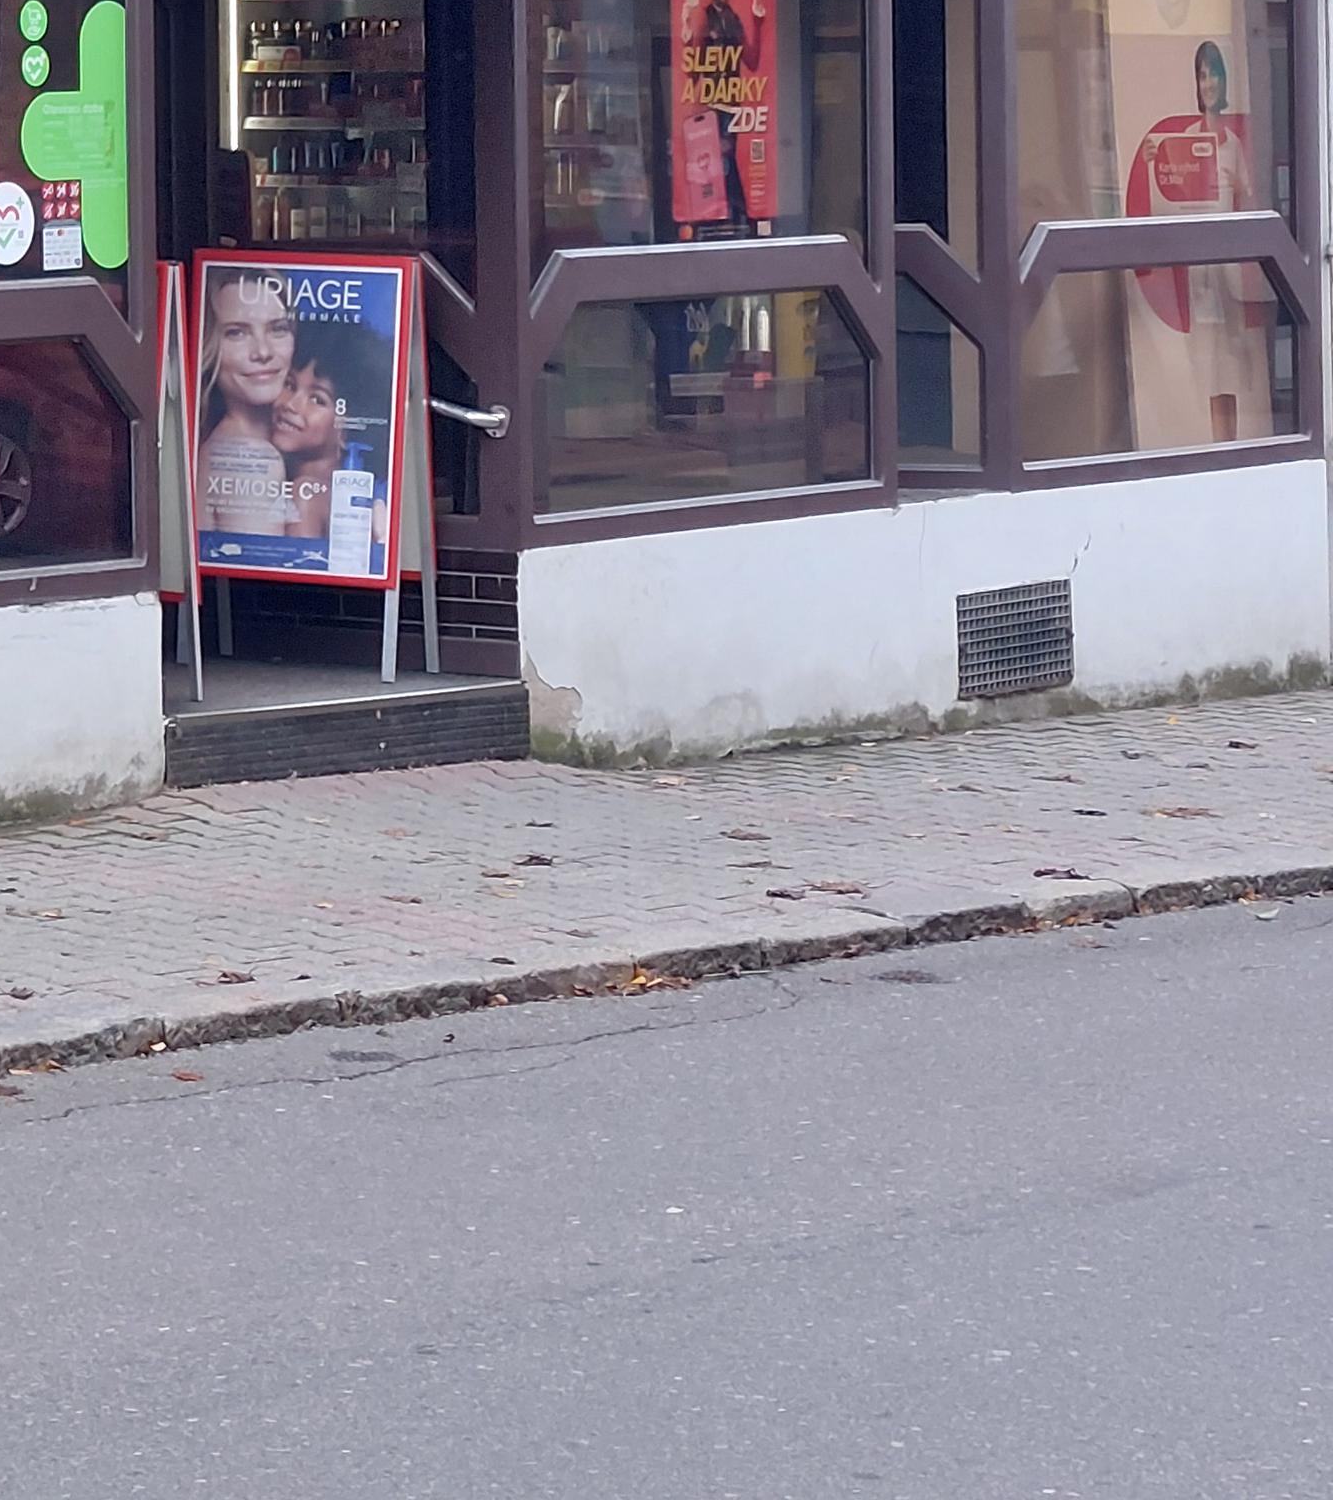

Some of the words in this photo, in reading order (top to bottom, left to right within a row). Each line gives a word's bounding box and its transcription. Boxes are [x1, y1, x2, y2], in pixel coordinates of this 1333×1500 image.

[681, 45, 743, 73] SLEVY
[680, 78, 695, 103] A
[699, 72, 769, 103] DÁRKY
[727, 105, 769, 133] ZDE
[238, 274, 363, 311] URIAGE
[283, 310, 361, 324] HERMALE
[335, 398, 346, 416] 8
[207, 476, 294, 499] XEMOSE
